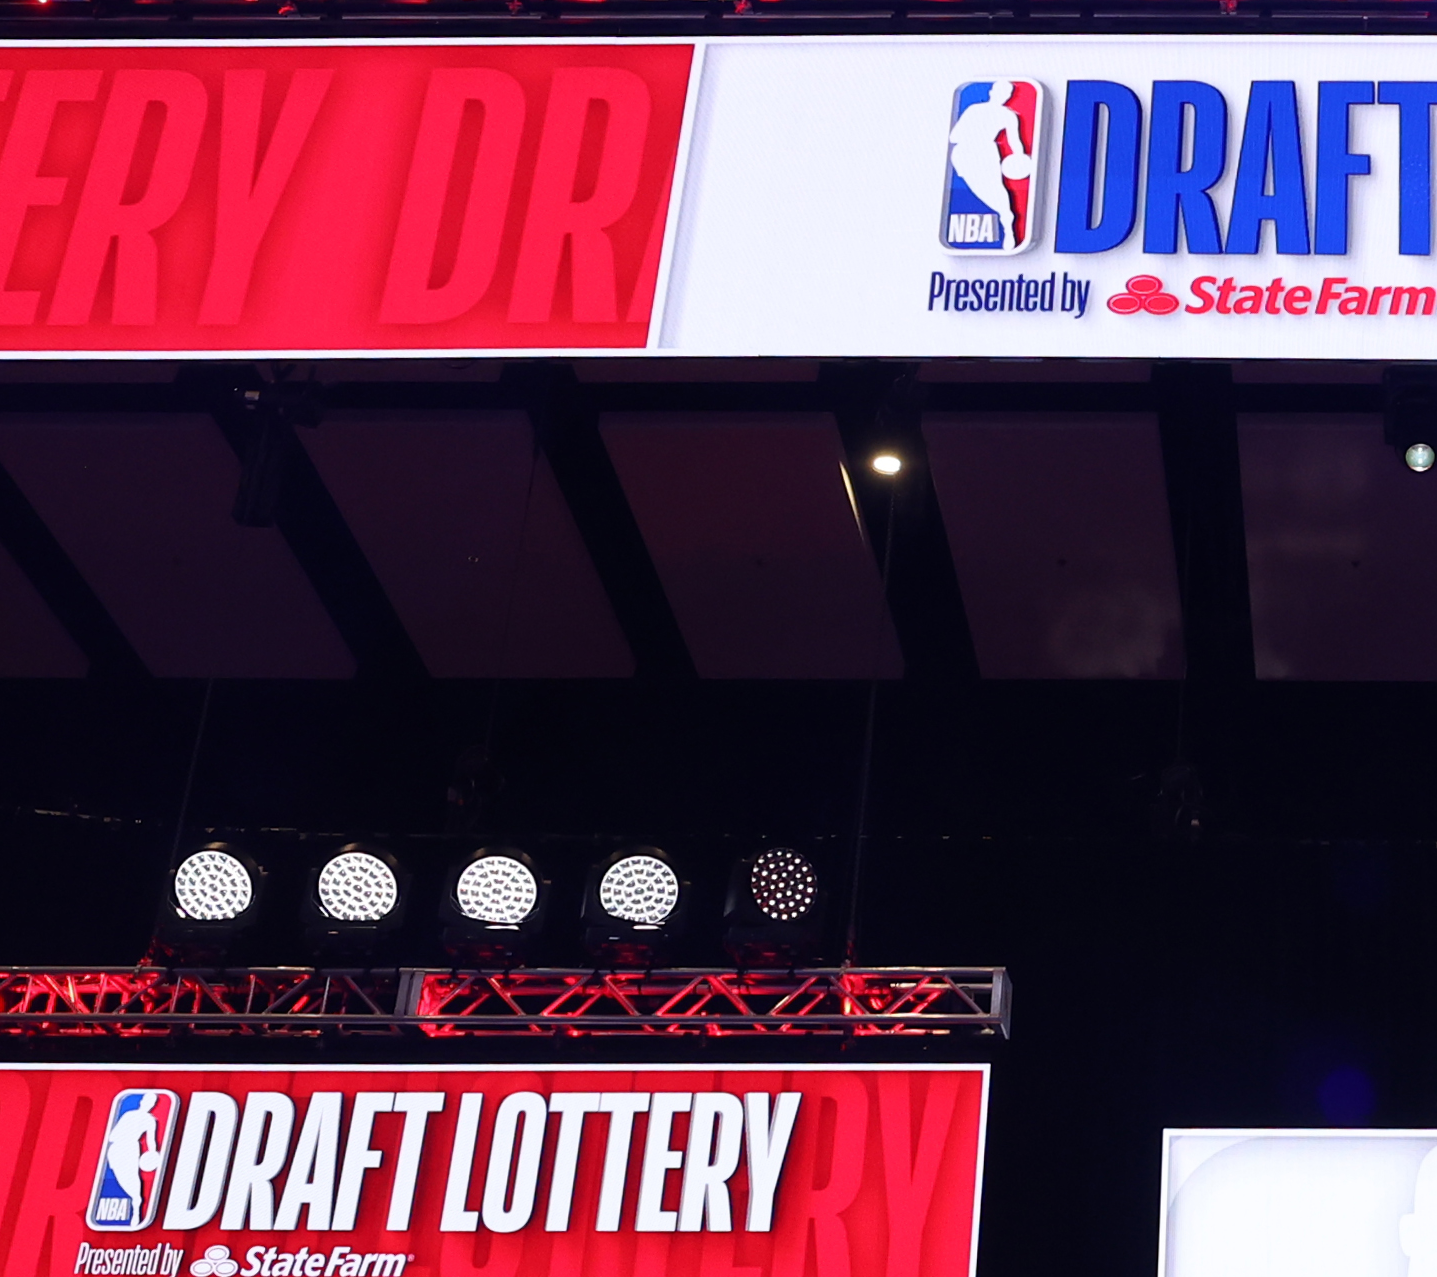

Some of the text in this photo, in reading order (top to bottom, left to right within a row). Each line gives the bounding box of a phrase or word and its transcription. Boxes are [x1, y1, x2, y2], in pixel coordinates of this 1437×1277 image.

[375, 65, 675, 326] DR
[947, 212, 997, 244] NBA
[927, 270, 1056, 313] Presented
[1061, 271, 1091, 319] by
[161, 1090, 446, 1231] DRAFT
[439, 1090, 803, 1233] LOTTERY
[95, 1196, 131, 1222] NBA
[73, 1241, 162, 1276] Presented
